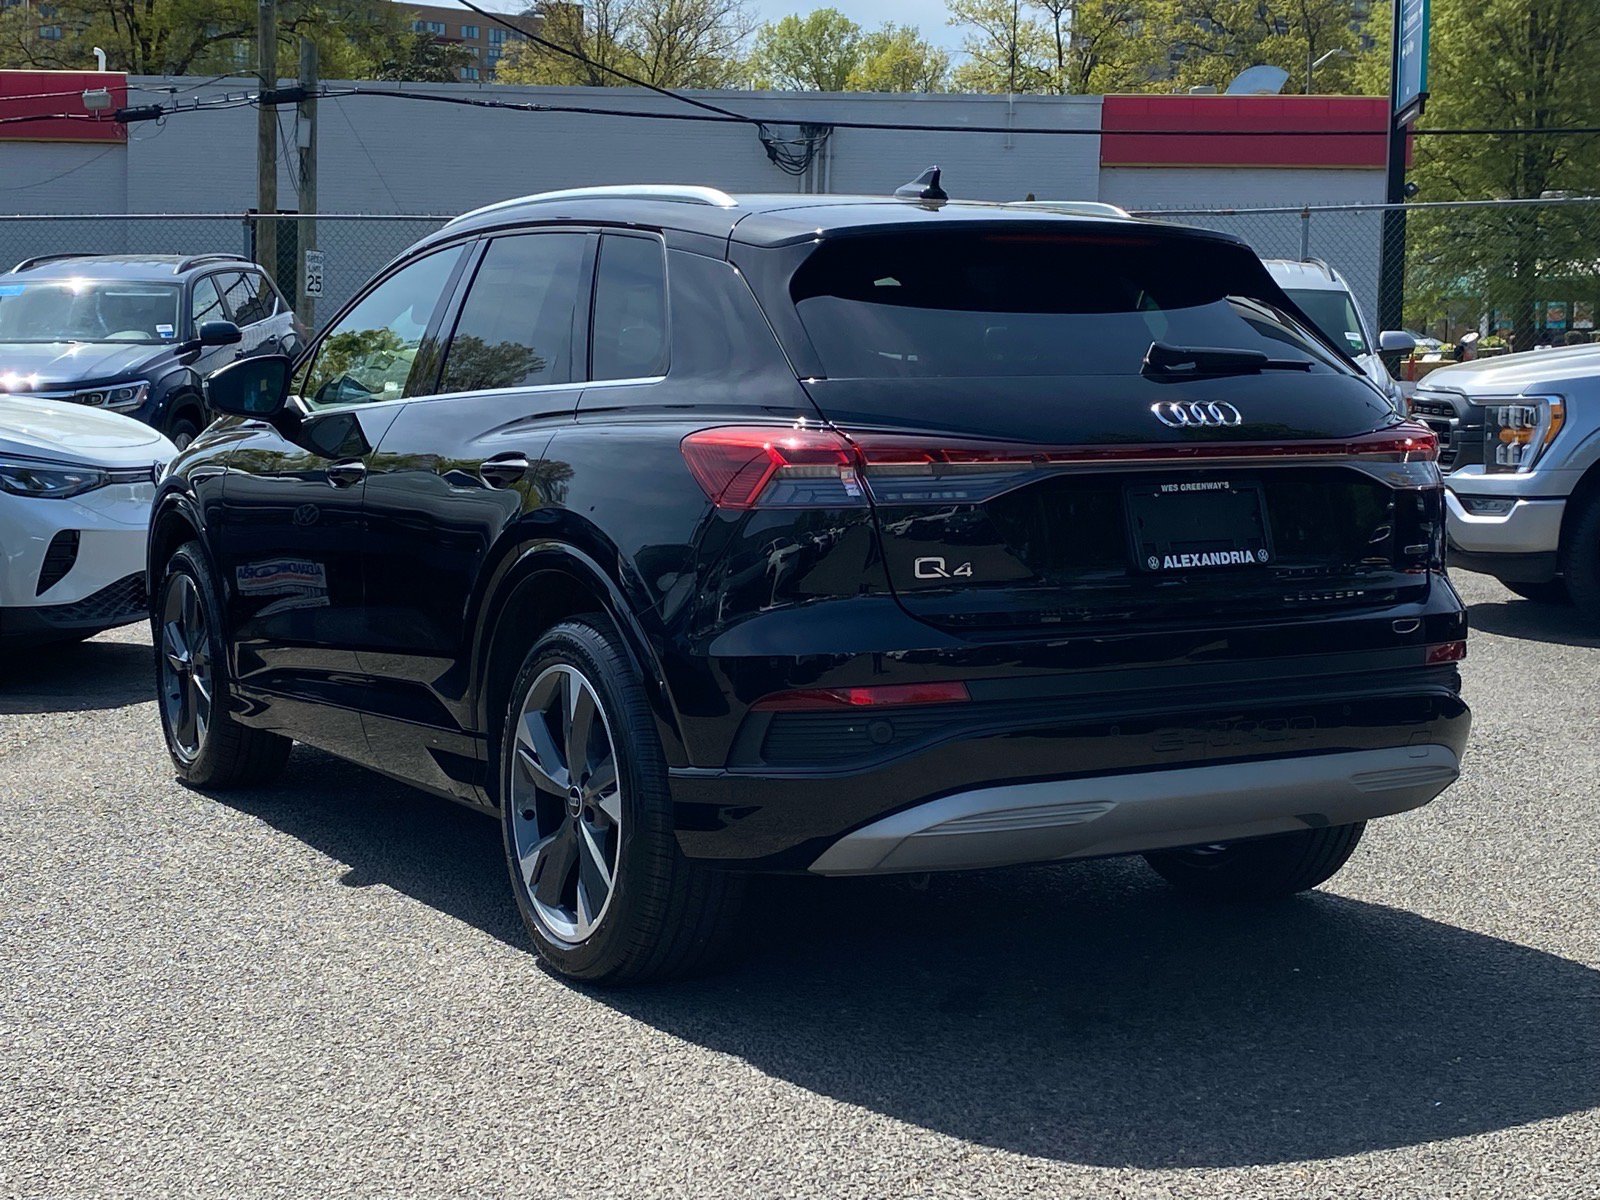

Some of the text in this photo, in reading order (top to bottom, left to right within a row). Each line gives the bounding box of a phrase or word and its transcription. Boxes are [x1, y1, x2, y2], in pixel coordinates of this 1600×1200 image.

[307, 275, 322, 293] 25
[1161, 481, 1230, 493] WES GREENWAY'S
[914, 557, 973, 579] Q4
[1163, 550, 1255, 569] ALEXANDRIA
